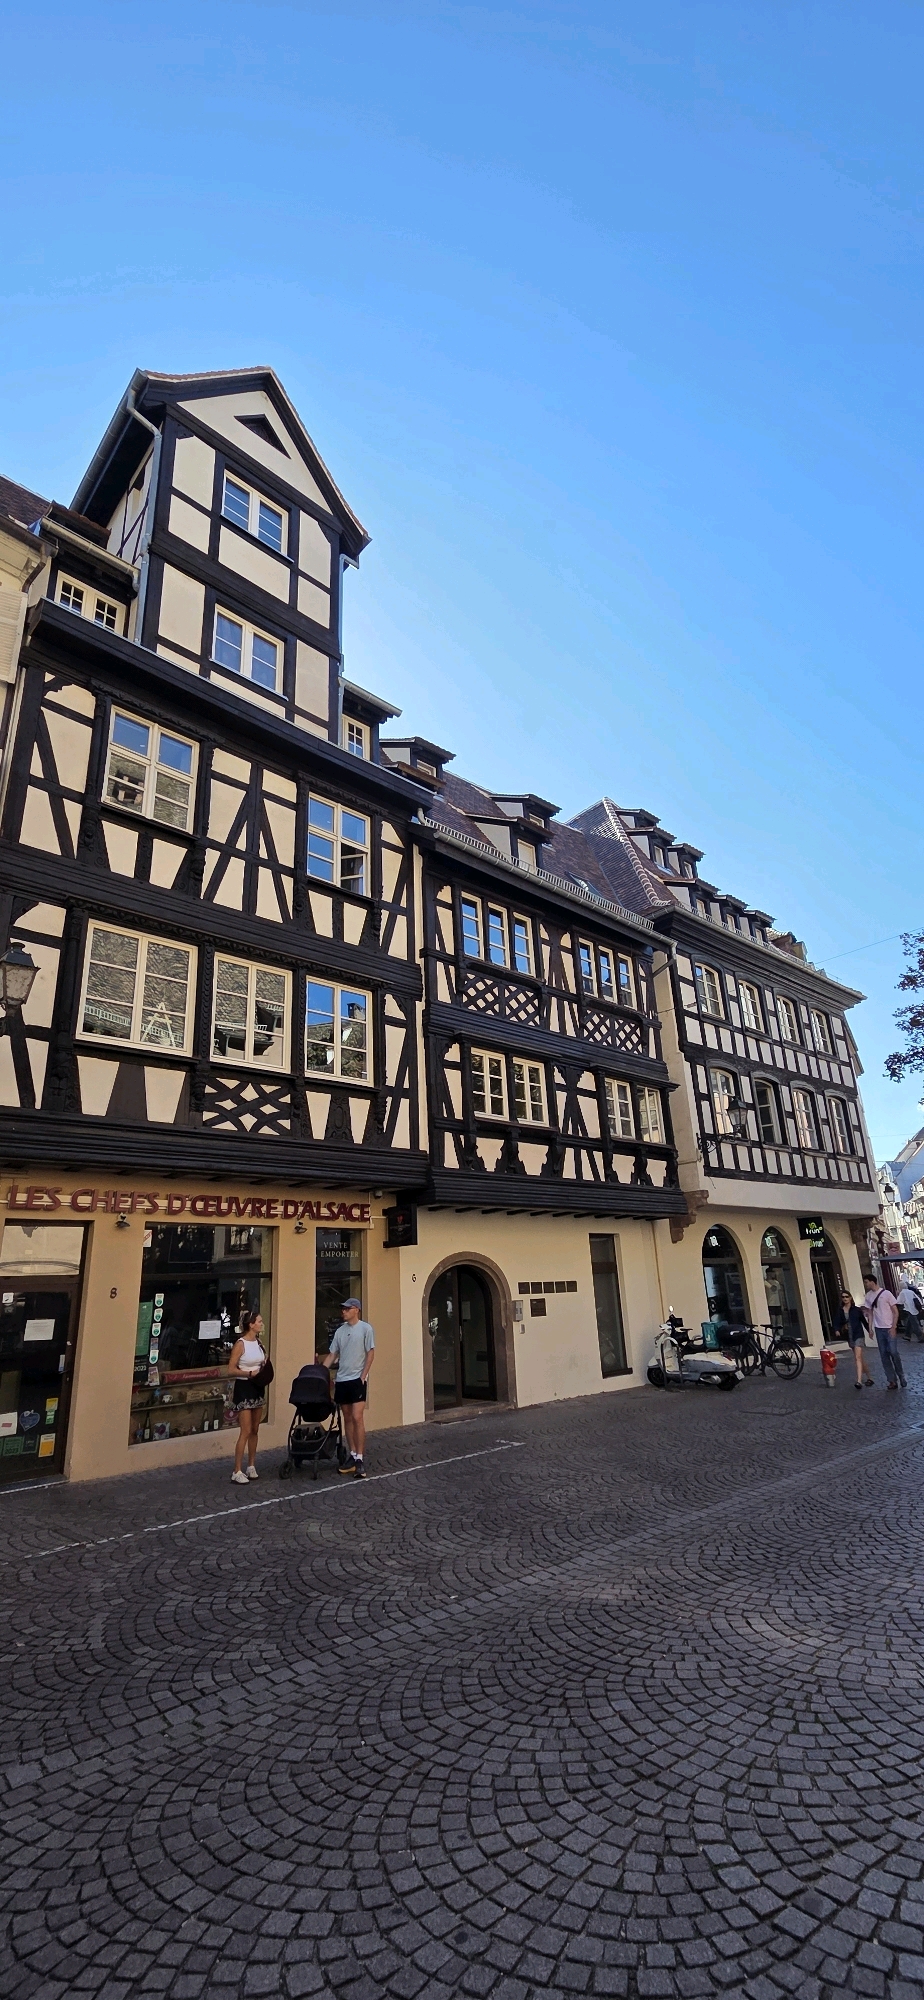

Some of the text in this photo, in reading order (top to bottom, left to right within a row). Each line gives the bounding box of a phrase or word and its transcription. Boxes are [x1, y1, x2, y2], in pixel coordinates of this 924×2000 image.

[7, 1184, 371, 1222] LES CHEFS D'ŒUVRE D'ALSACE
[323, 1241, 348, 1249] VENTE
[320, 1250, 359, 1258] EMPORTER
[411, 1273, 417, 1283] 6
[109, 1287, 118, 1299] 8
